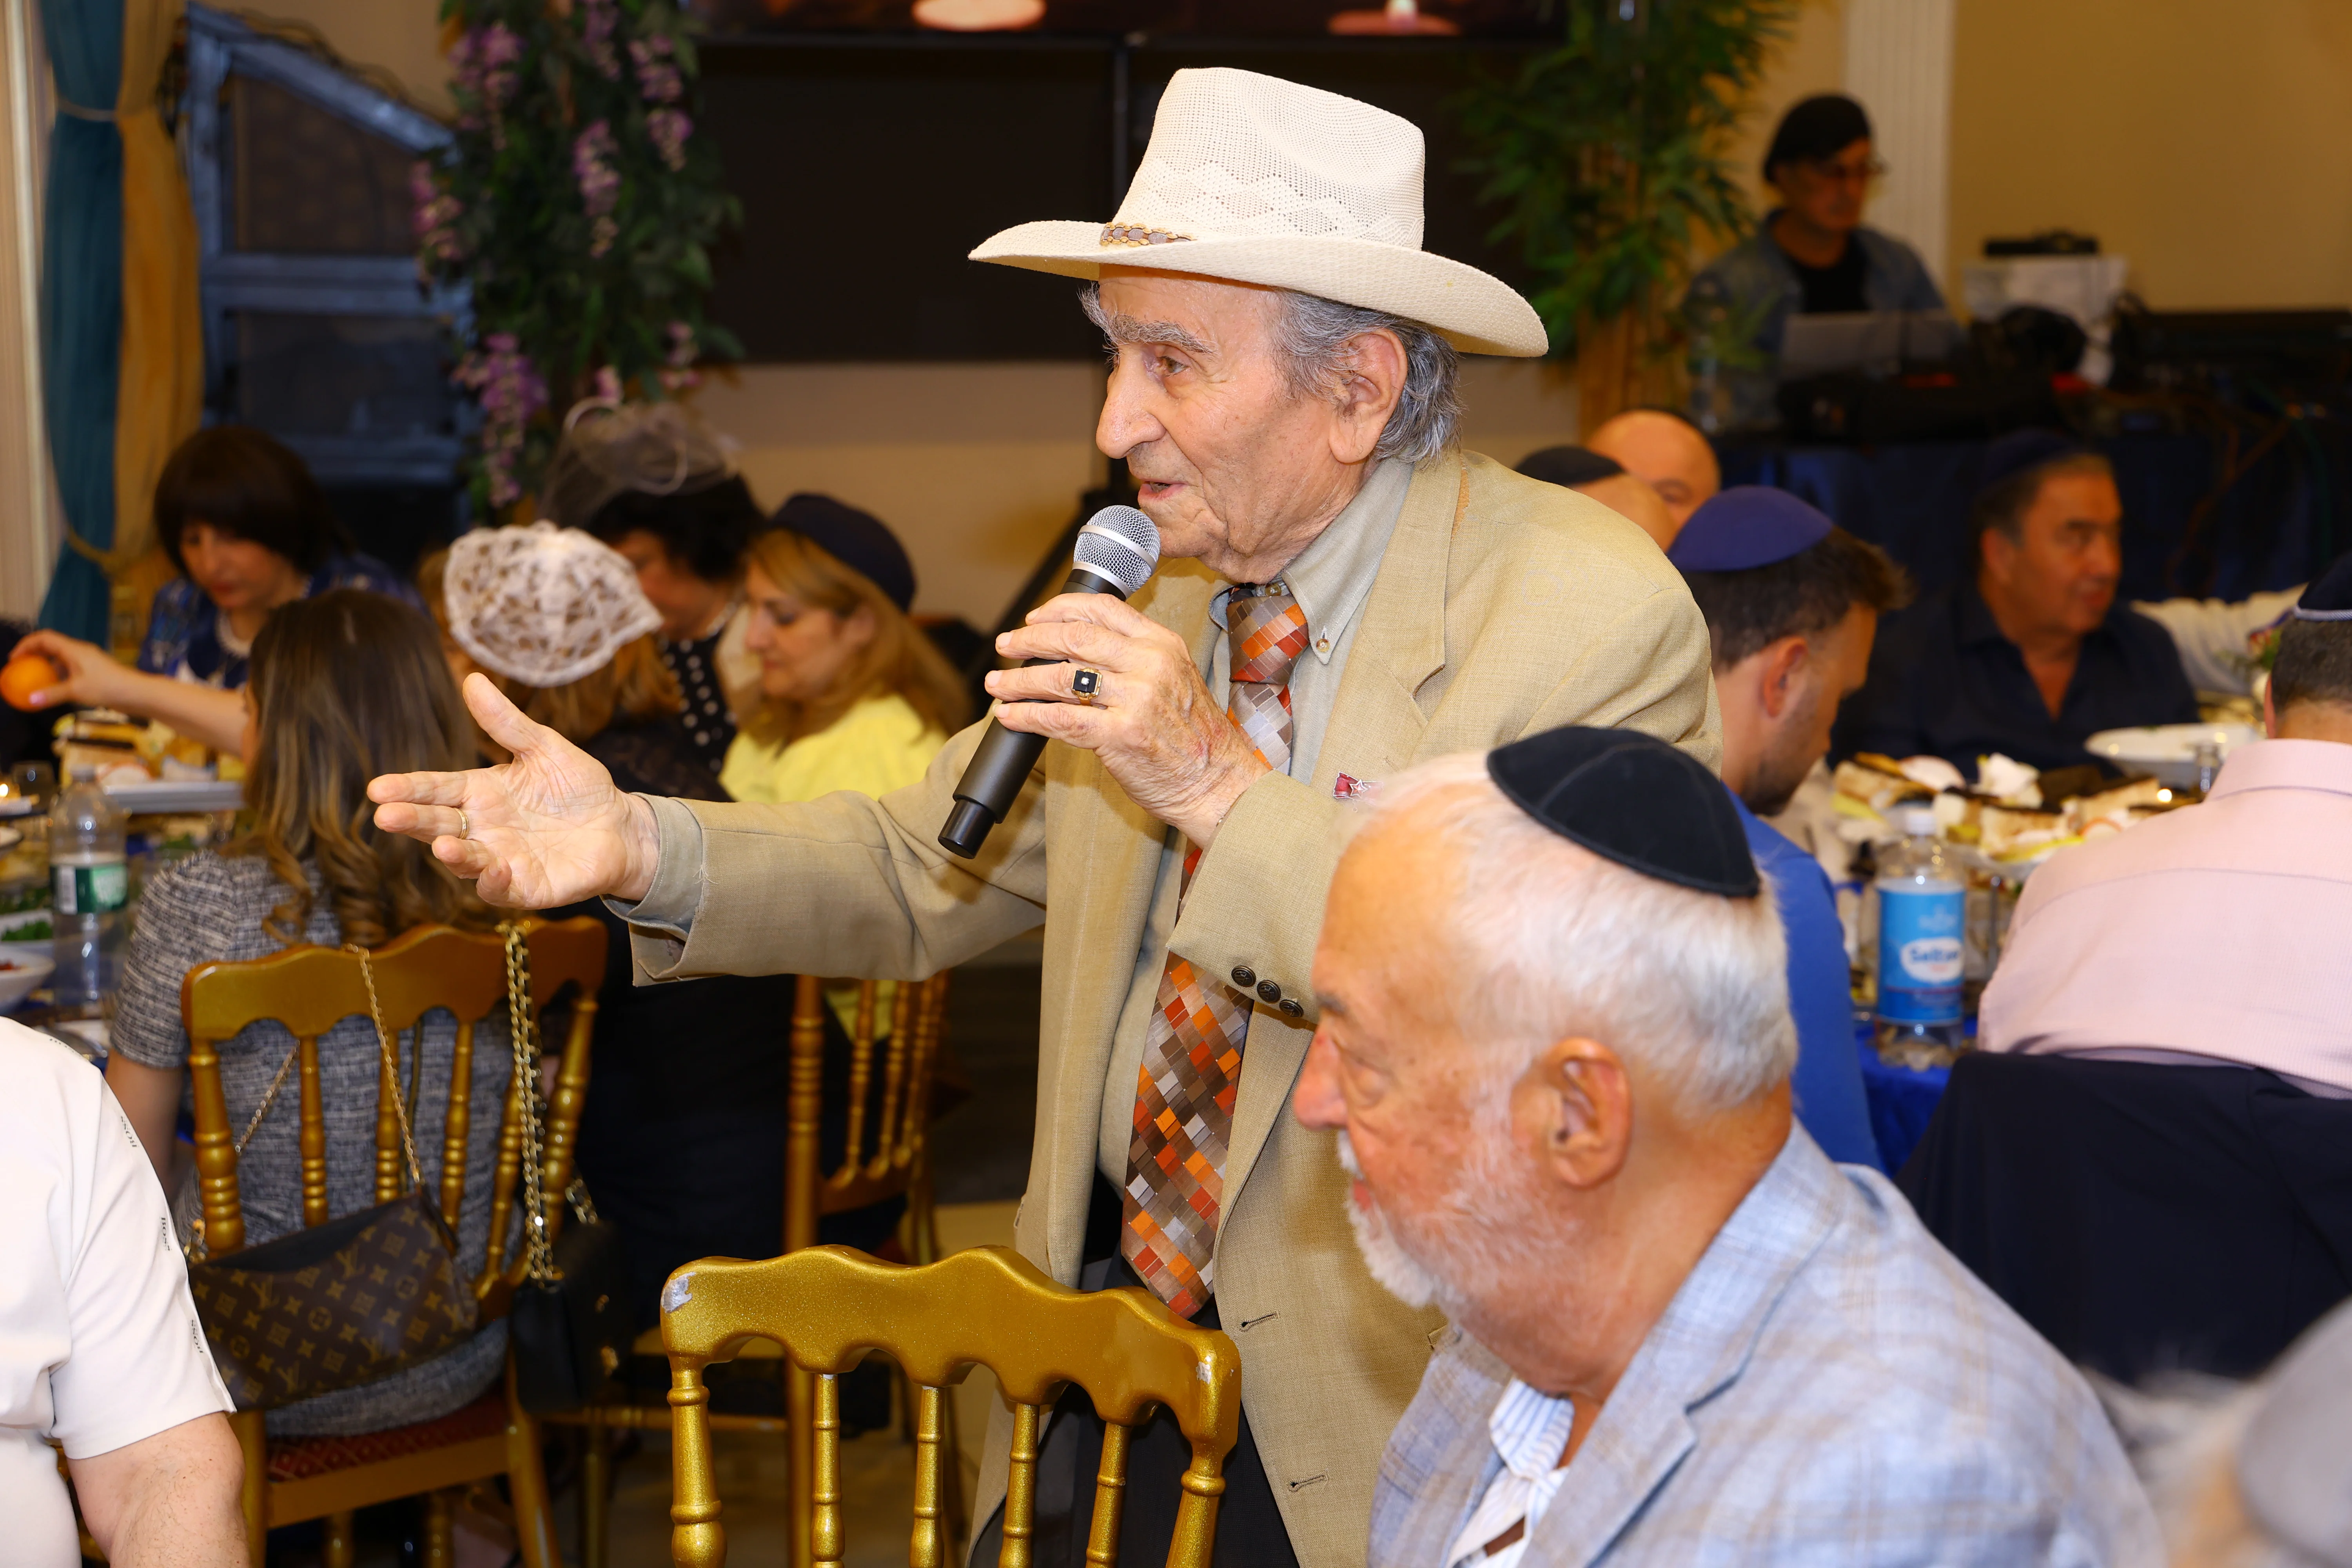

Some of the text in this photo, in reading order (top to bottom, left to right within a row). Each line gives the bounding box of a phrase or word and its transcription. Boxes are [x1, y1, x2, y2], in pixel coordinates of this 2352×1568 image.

[121, 1115, 138, 1147] BOSS
[161, 1217, 171, 1251] BOSS
[191, 1319, 204, 1353] BOSS
